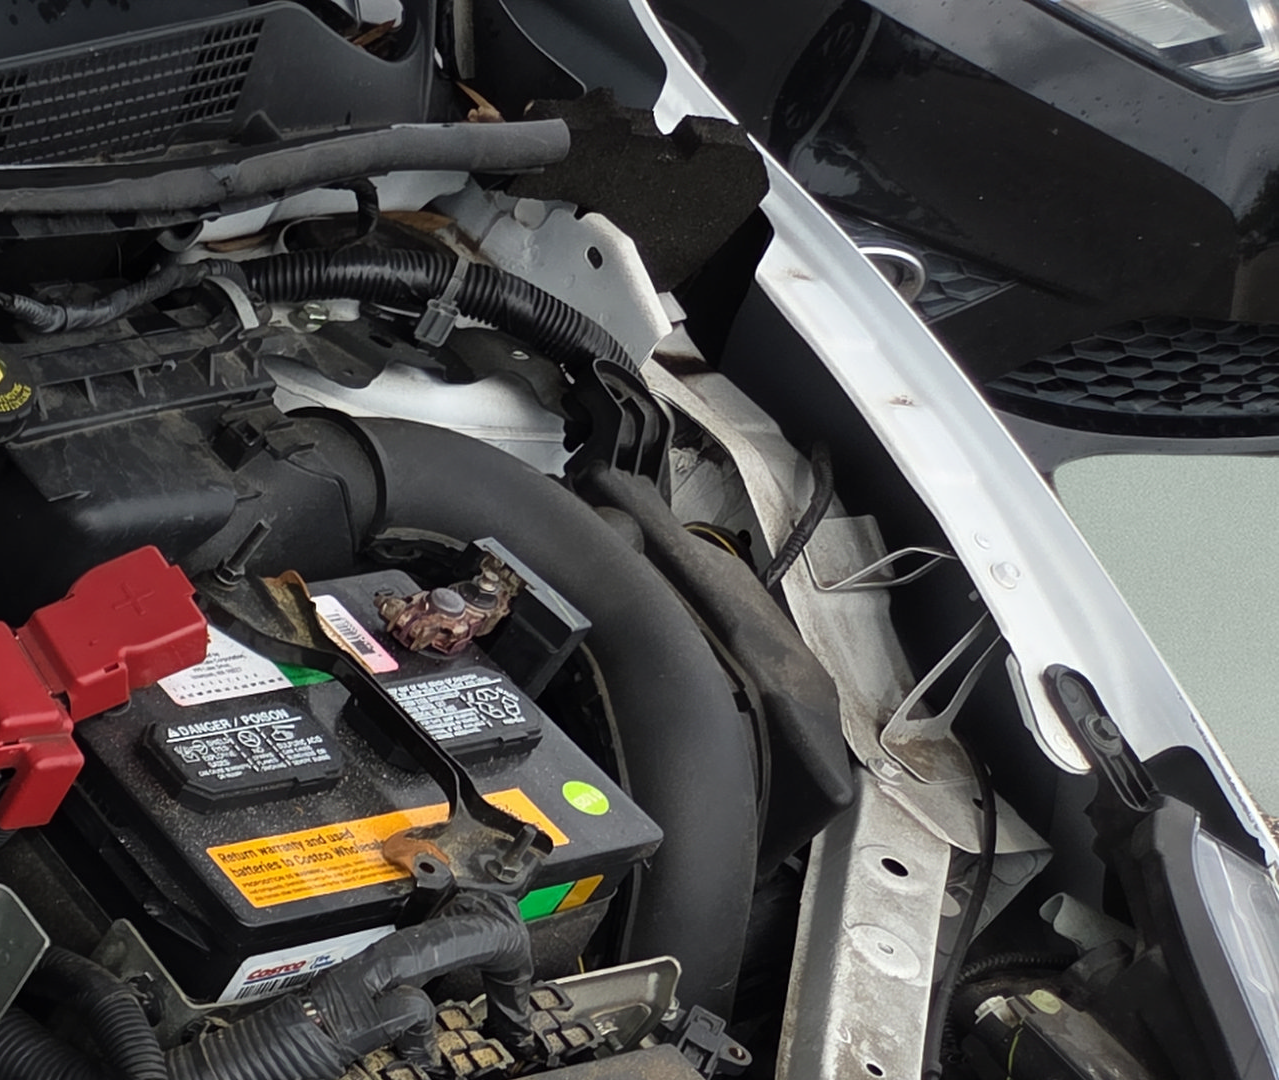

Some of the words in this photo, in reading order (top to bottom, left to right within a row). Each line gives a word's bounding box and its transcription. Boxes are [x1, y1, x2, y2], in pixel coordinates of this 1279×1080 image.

[177, 718, 232, 737] DANGER
[234, 717, 239, 727] /
[242, 708, 290, 725] POISON
[217, 847, 257, 864] Return
[258, 840, 305, 858] warranty
[304, 833, 328, 849] and
[328, 828, 356, 843] used
[229, 858, 283, 879] batteries
[283, 856, 294, 869] to
[294, 850, 334, 867] Costco
